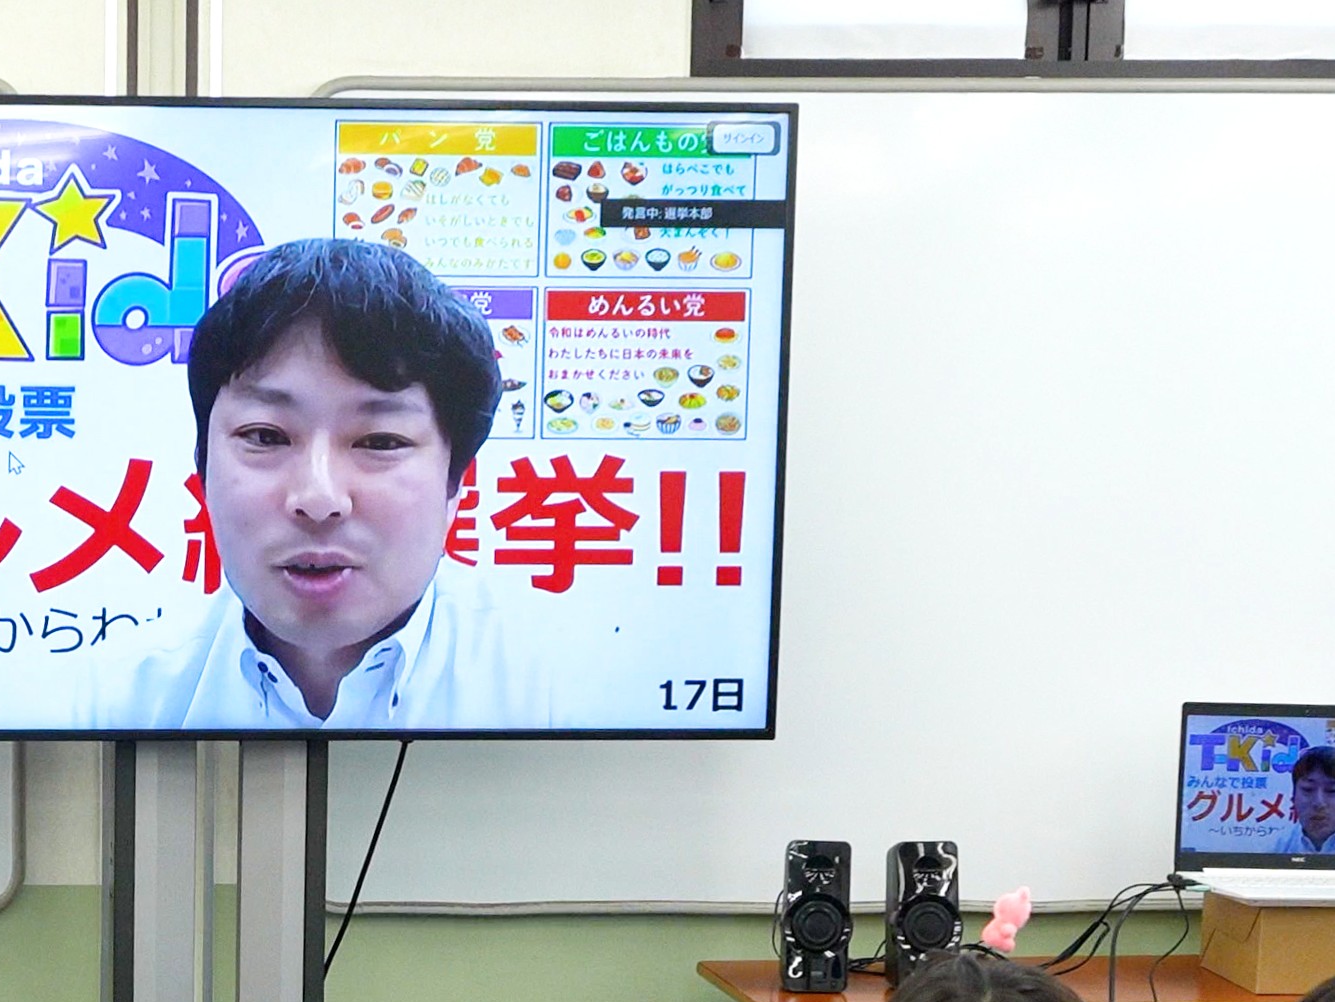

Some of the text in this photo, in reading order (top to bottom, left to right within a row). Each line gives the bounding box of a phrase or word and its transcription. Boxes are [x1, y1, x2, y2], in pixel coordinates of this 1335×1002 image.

[378, 127, 497, 152] パン党
[583, 129, 709, 154] ごはんもの
[588, 294, 706, 317] めんるい党
[658, 677, 745, 713] 17日
[1187, 775, 1268, 790] みんなで投票
